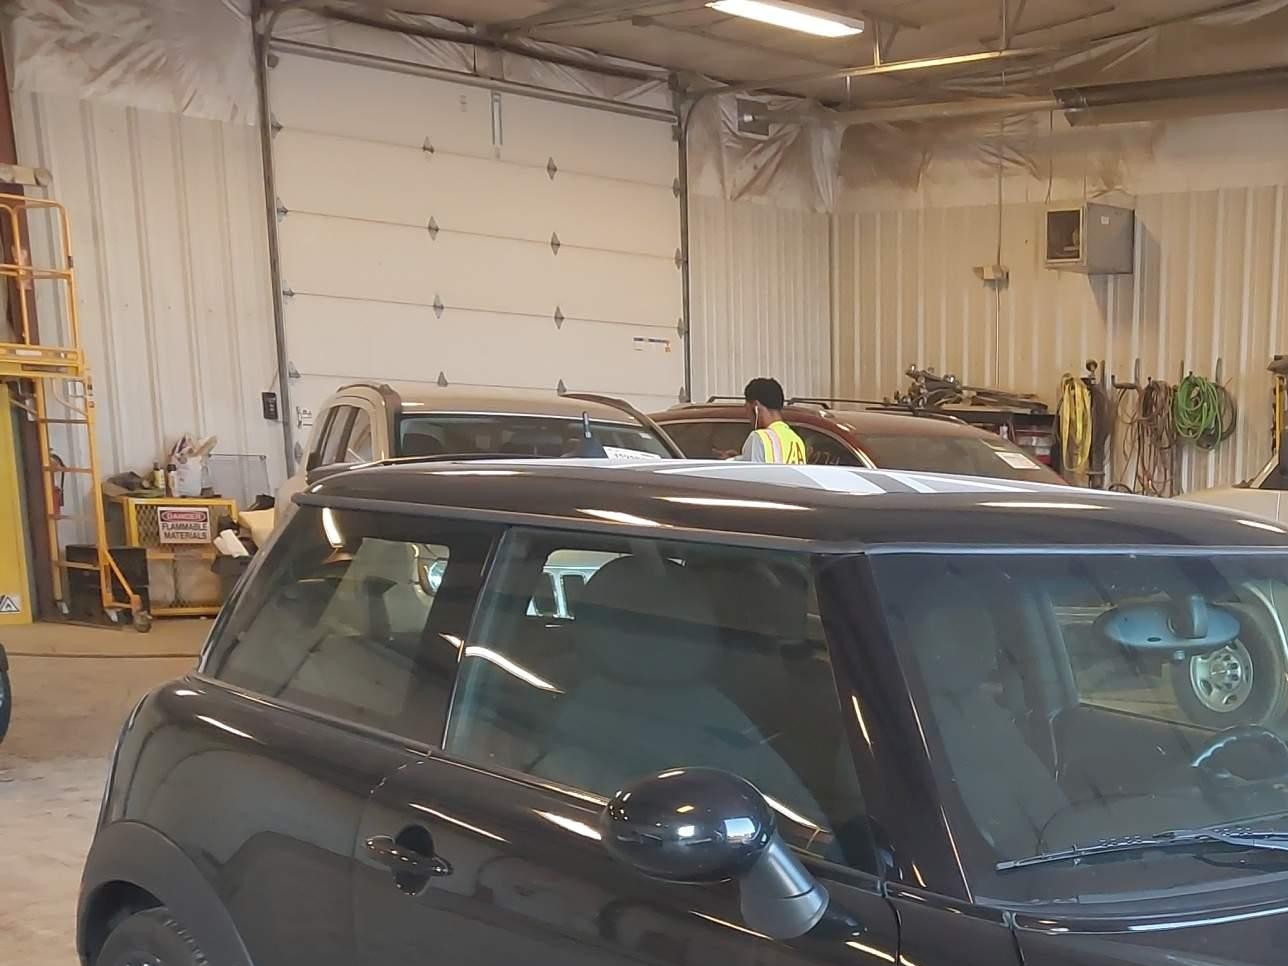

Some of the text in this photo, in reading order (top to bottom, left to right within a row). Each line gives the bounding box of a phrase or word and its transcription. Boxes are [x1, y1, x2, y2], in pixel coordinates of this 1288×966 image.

[166, 512, 202, 520] DANGER
[161, 522, 208, 531] FLAMMABLE
[163, 531, 207, 540] MATERIALS
